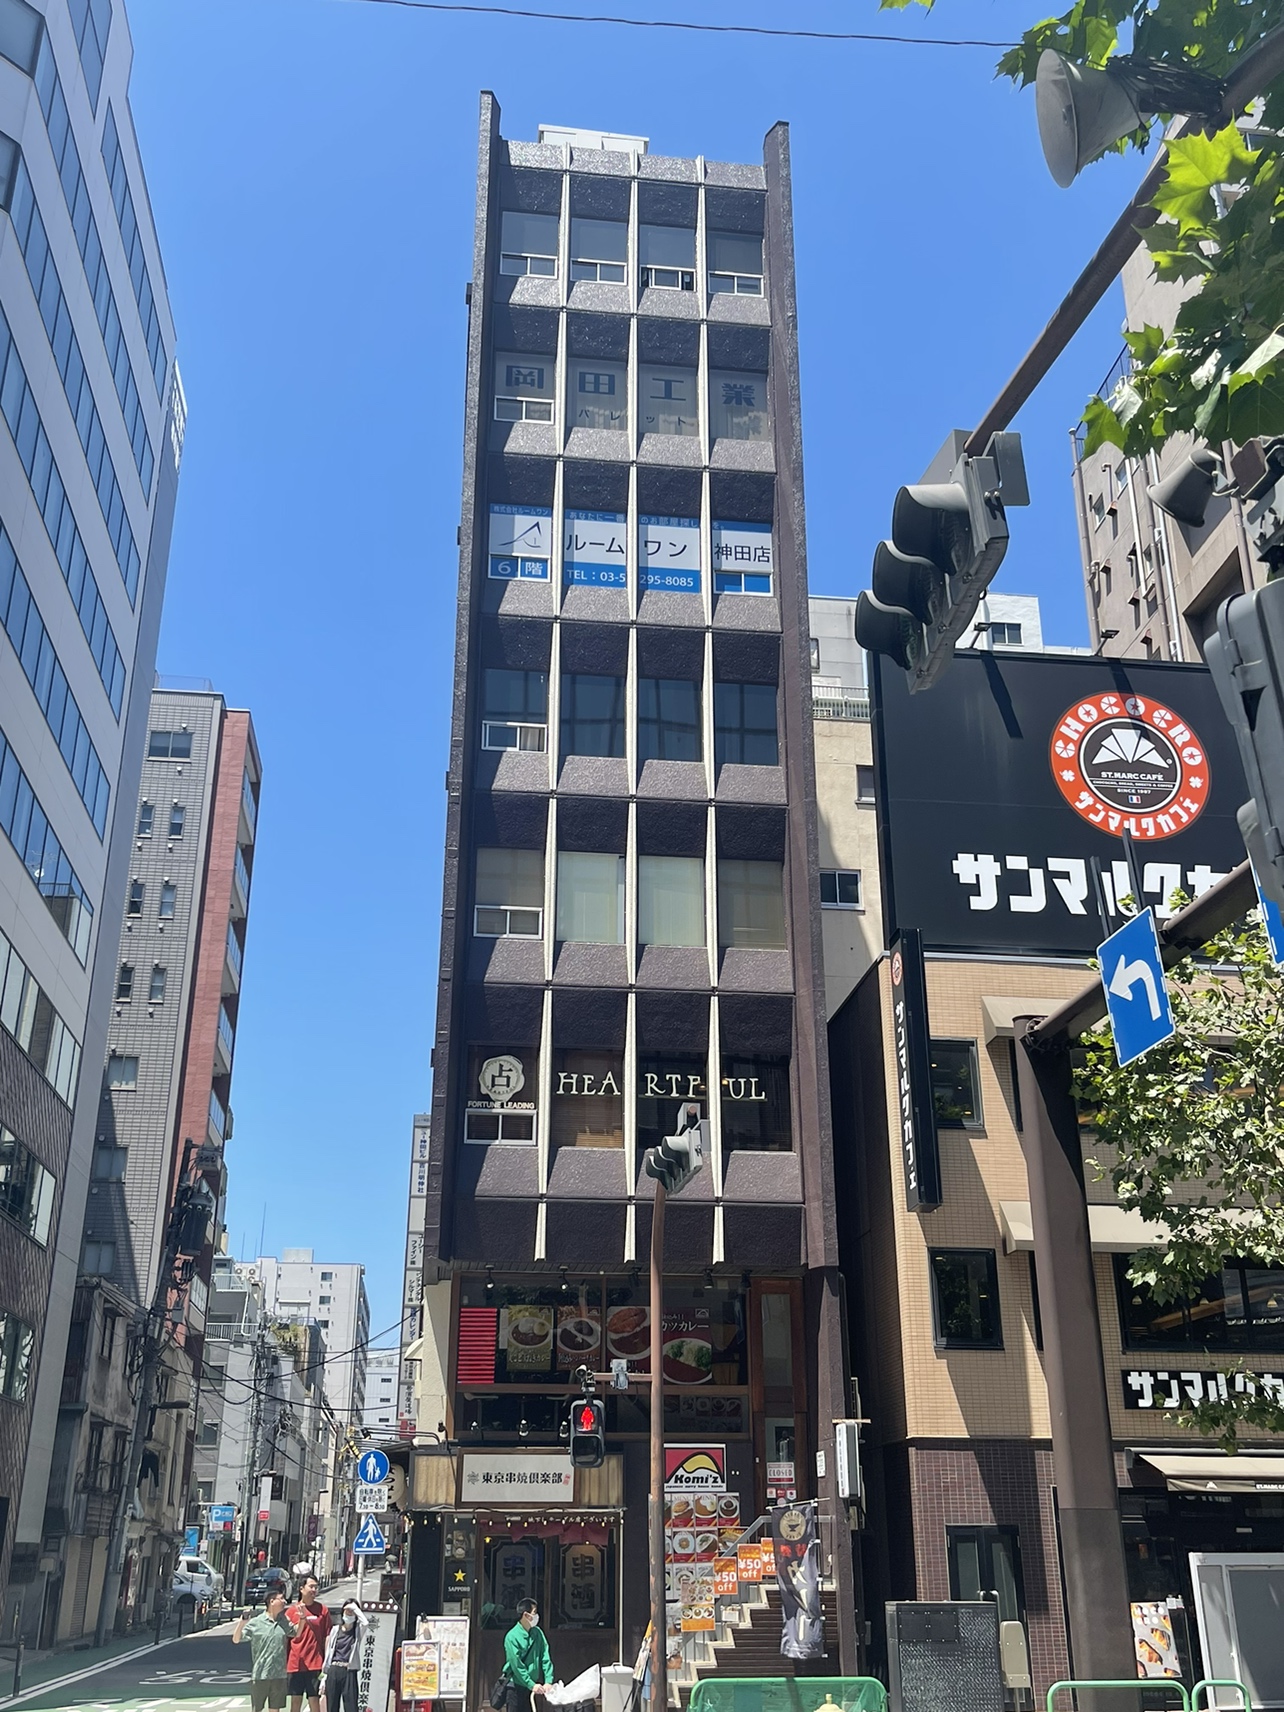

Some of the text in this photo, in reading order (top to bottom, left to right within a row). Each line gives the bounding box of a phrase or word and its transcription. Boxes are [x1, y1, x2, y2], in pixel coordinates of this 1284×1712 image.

[714, 543, 770, 563] 神田店
[768, 1469, 793, 1477] CLOSED
[482, 1472, 562, 1484] 東京串焼倶楽部
[674, 1475, 719, 1484] Komi'z
[213, 1509, 221, 1521] P
[738, 1559, 761, 1569] ¥50
[743, 1569, 758, 1578] off
[718, 1583, 733, 1591] off
